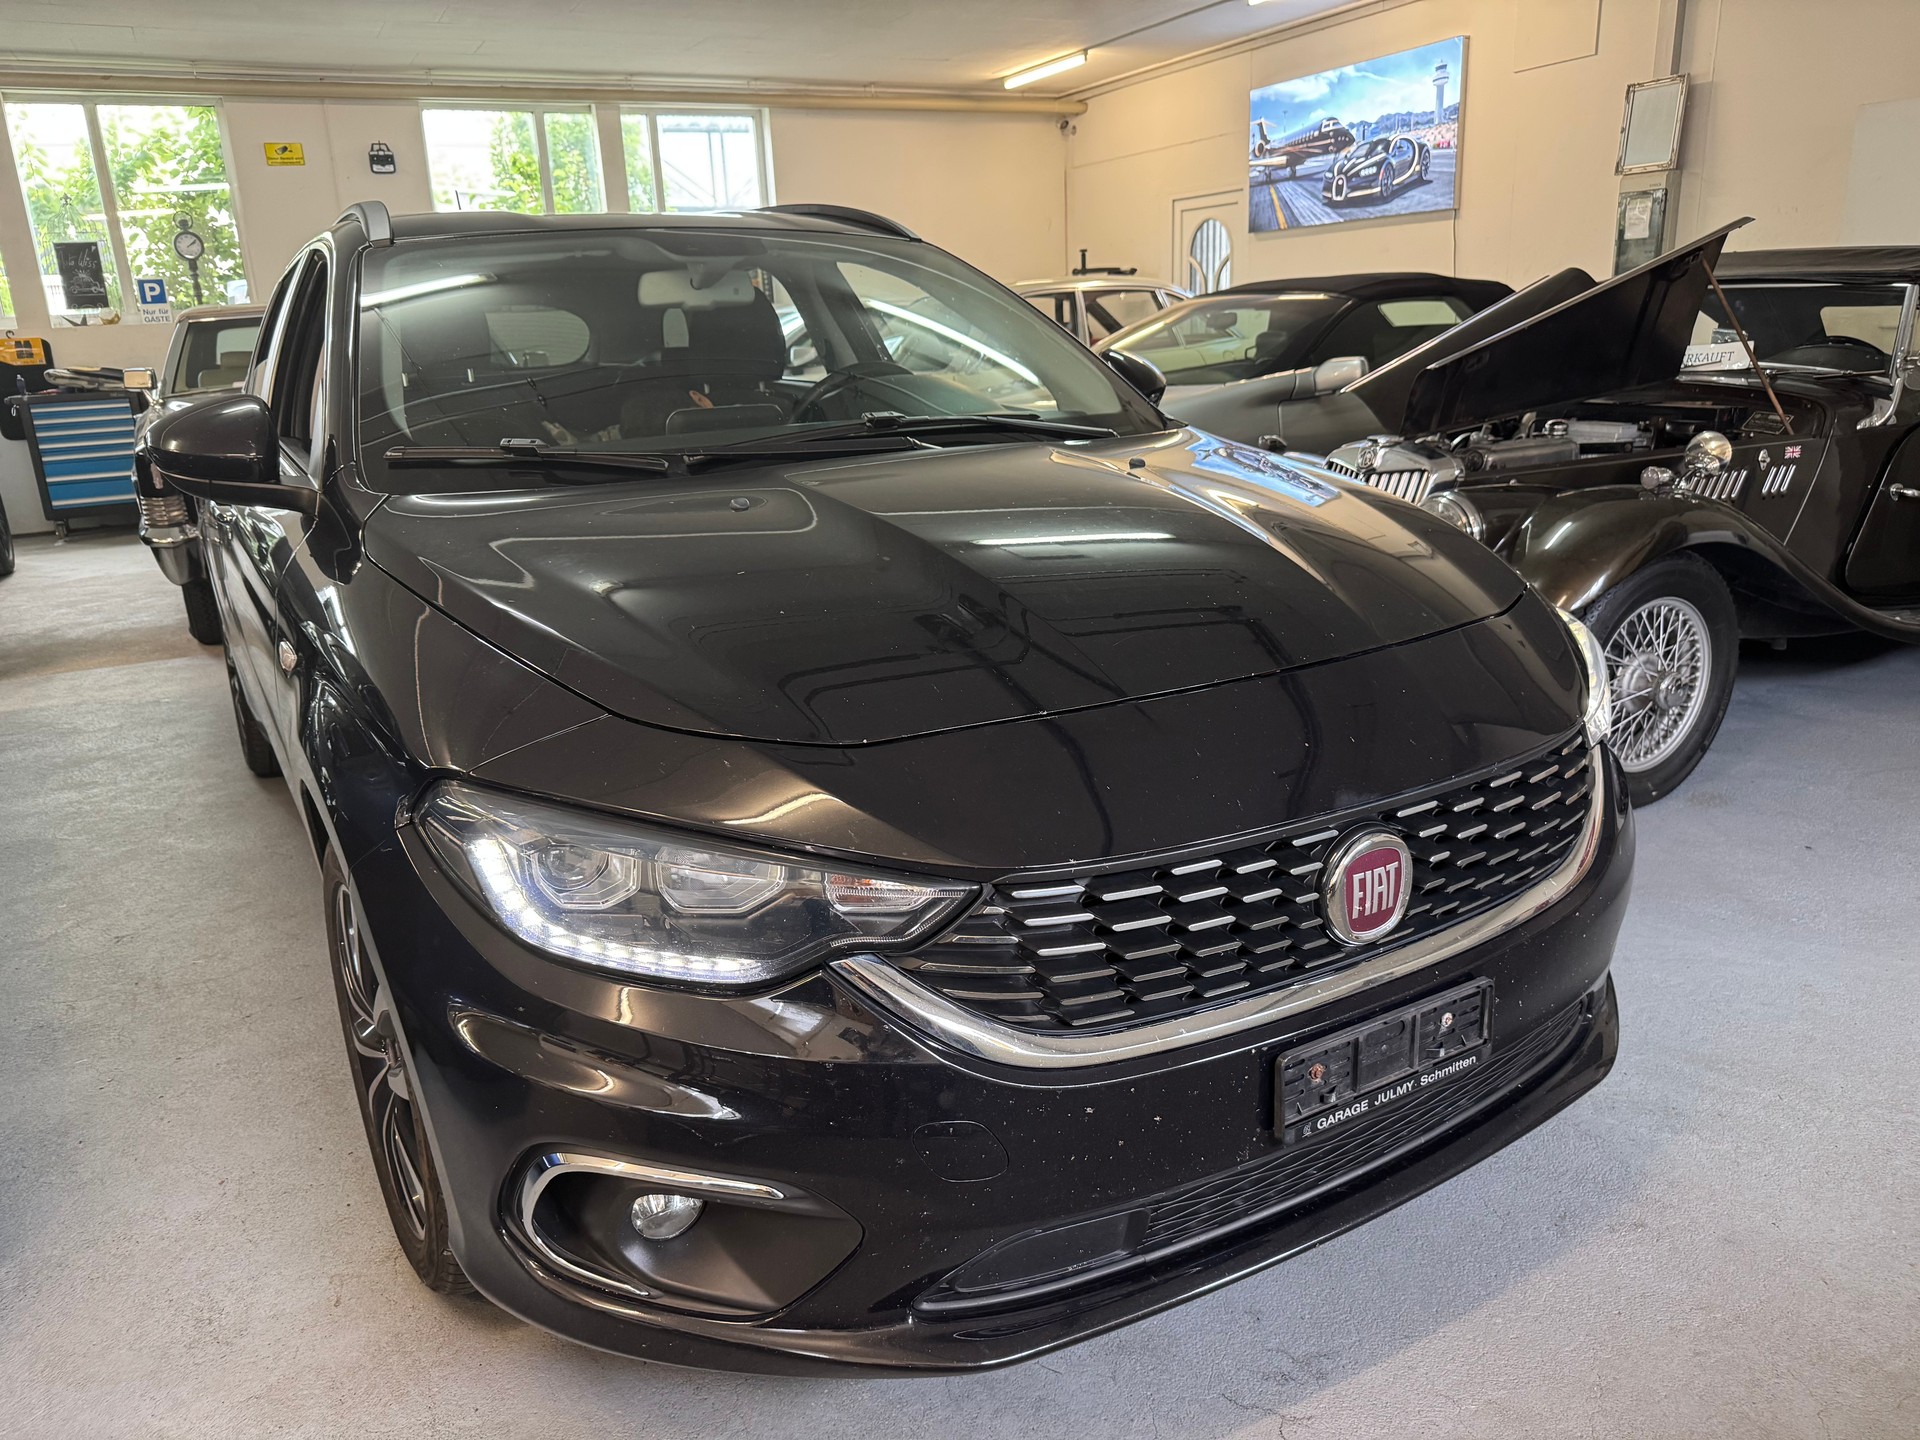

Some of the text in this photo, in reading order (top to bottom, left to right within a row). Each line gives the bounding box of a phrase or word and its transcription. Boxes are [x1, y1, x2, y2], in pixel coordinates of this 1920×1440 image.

[143, 282, 160, 302] P
[1685, 351, 1735, 363] RKAUFT
[1352, 861, 1399, 919] FIAT
[1316, 1099, 1369, 1130] GARAGE
[1420, 1055, 1477, 1086] Schmitten
